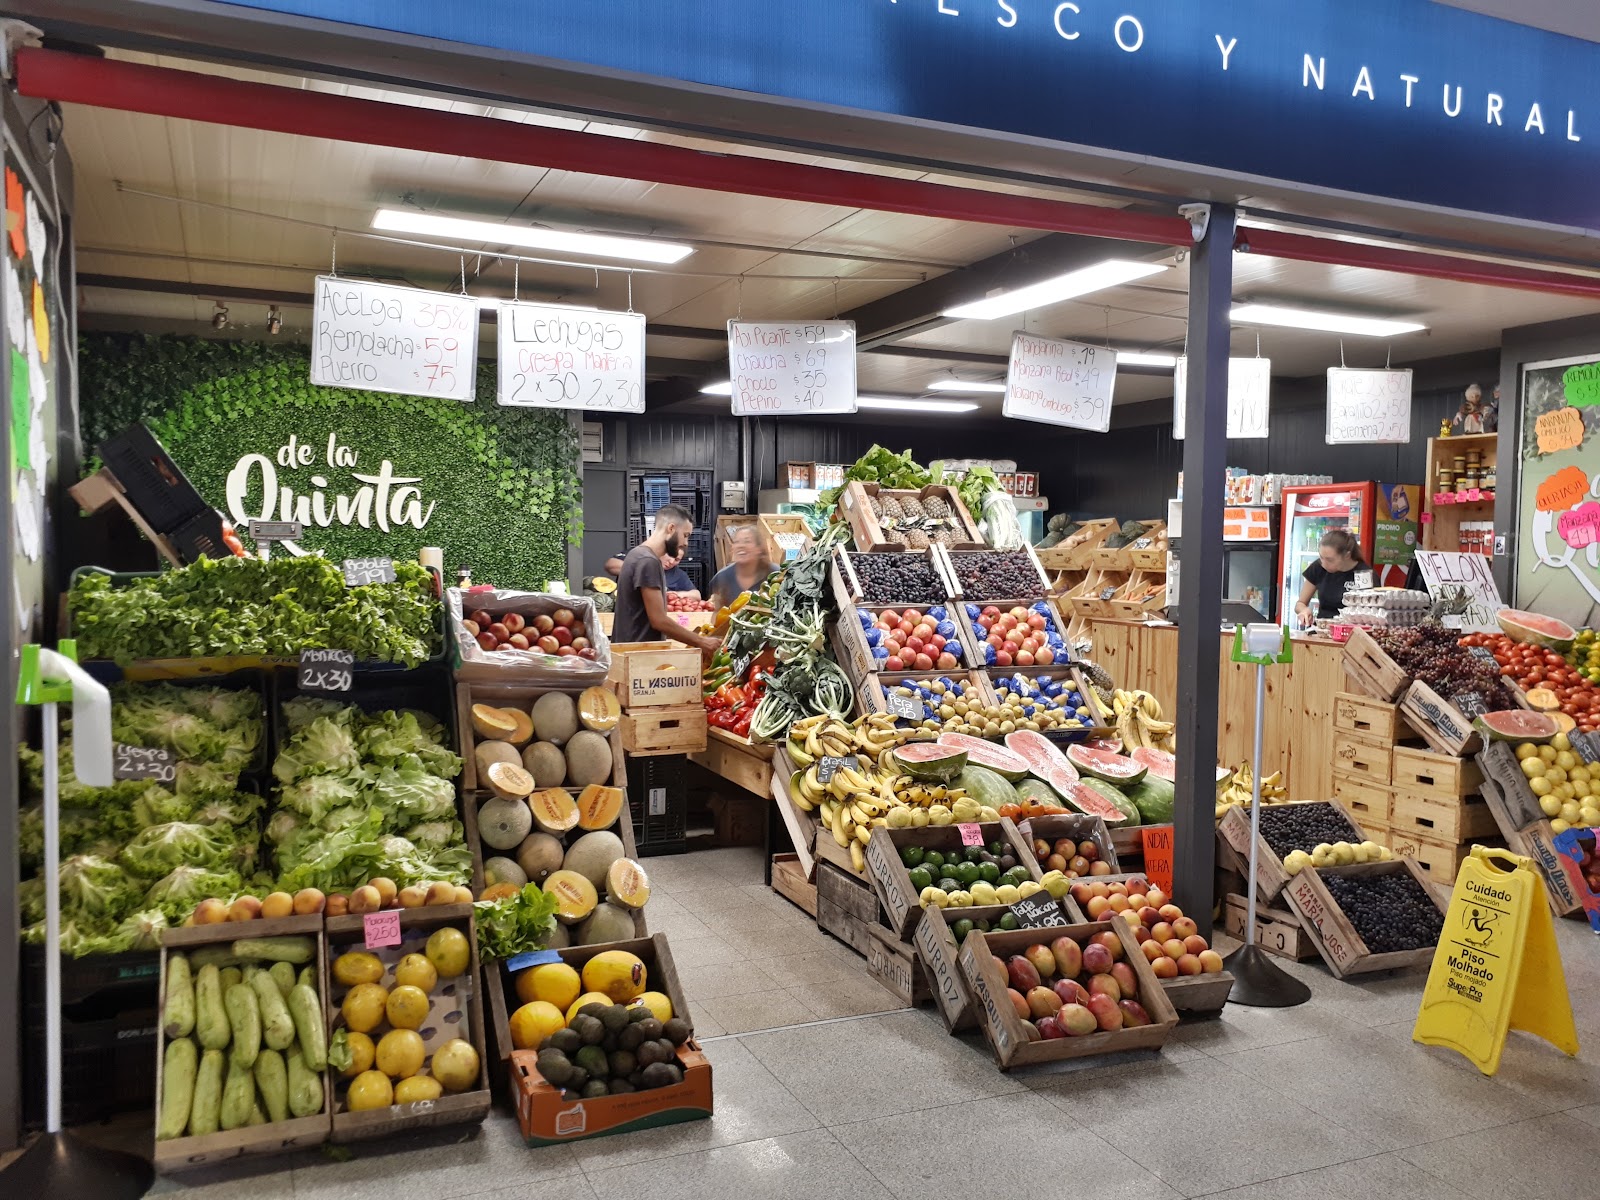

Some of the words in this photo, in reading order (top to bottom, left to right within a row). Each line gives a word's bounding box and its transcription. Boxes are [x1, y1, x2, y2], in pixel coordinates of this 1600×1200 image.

[1214, 35, 1238, 70] Y
[1302, 53, 1581, 142] NATURAL
[512, 309, 623, 353] Lechugas
[321, 355, 378, 383] Puerro
[277, 434, 316, 470] de
[326, 432, 358, 468] la
[226, 453, 436, 558] Quinta
[1418, 552, 1489, 583] MELON
[633, 679, 646, 690] EL
[633, 689, 656, 697] GRANJA
[889, 693, 913, 709] Pera
[1466, 880, 1512, 902] Cuidado
[1472, 893, 1501, 908] Atención
[1295, 887, 1325, 930] MARIA
[1447, 955, 1494, 981] Molhado
[1461, 948, 1486, 966] Piso
[1450, 968, 1464, 980] Piso
[1463, 973, 1487, 987] mojado
